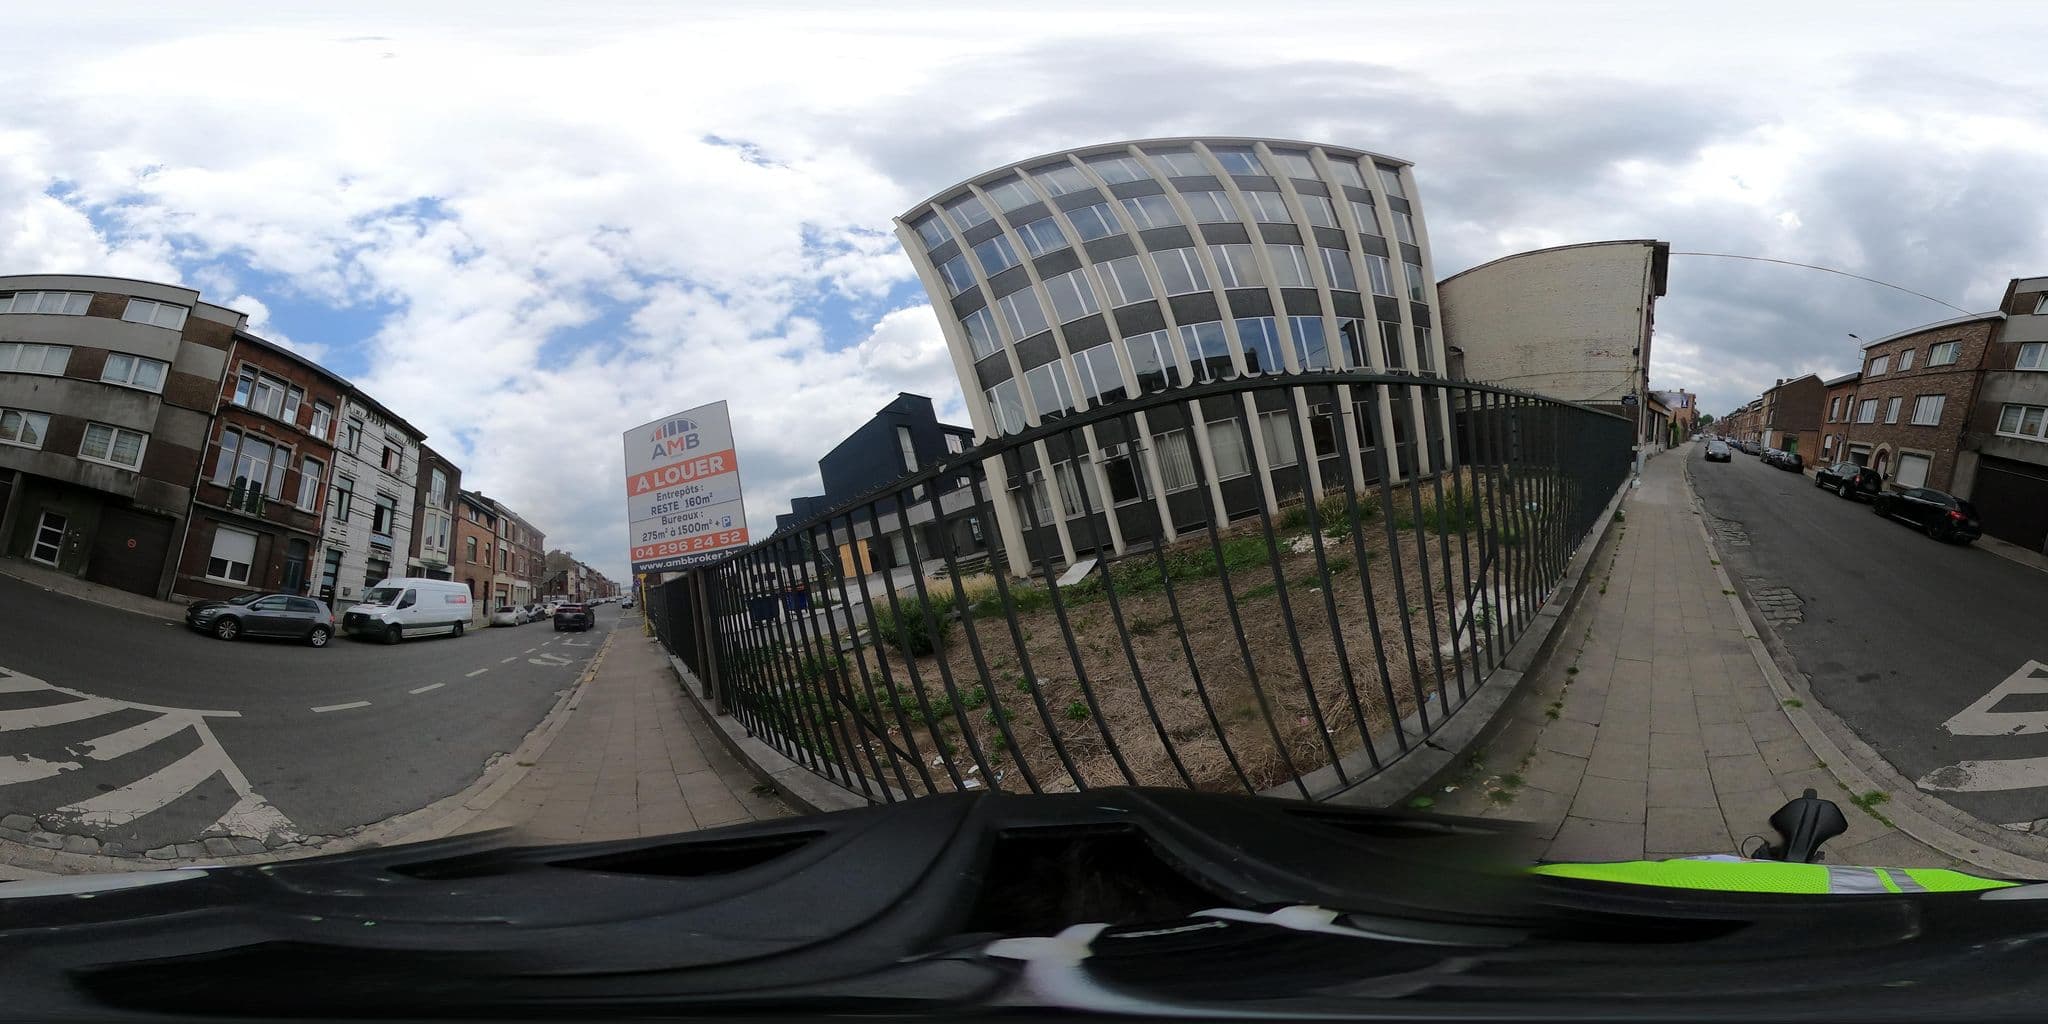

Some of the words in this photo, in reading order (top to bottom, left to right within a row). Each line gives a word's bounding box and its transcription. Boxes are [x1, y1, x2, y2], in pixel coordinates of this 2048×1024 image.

[652, 432, 700, 460] AMB
[636, 475, 650, 492] A
[654, 455, 724, 487] LOUER
[656, 485, 699, 502] Entrepôts
[651, 501, 680, 516] RESTE
[662, 511, 698, 526] Bureaux
[636, 547, 654, 558] 04
[658, 541, 688, 554] 296
[694, 536, 714, 550] 24
[720, 531, 742, 544] 52
